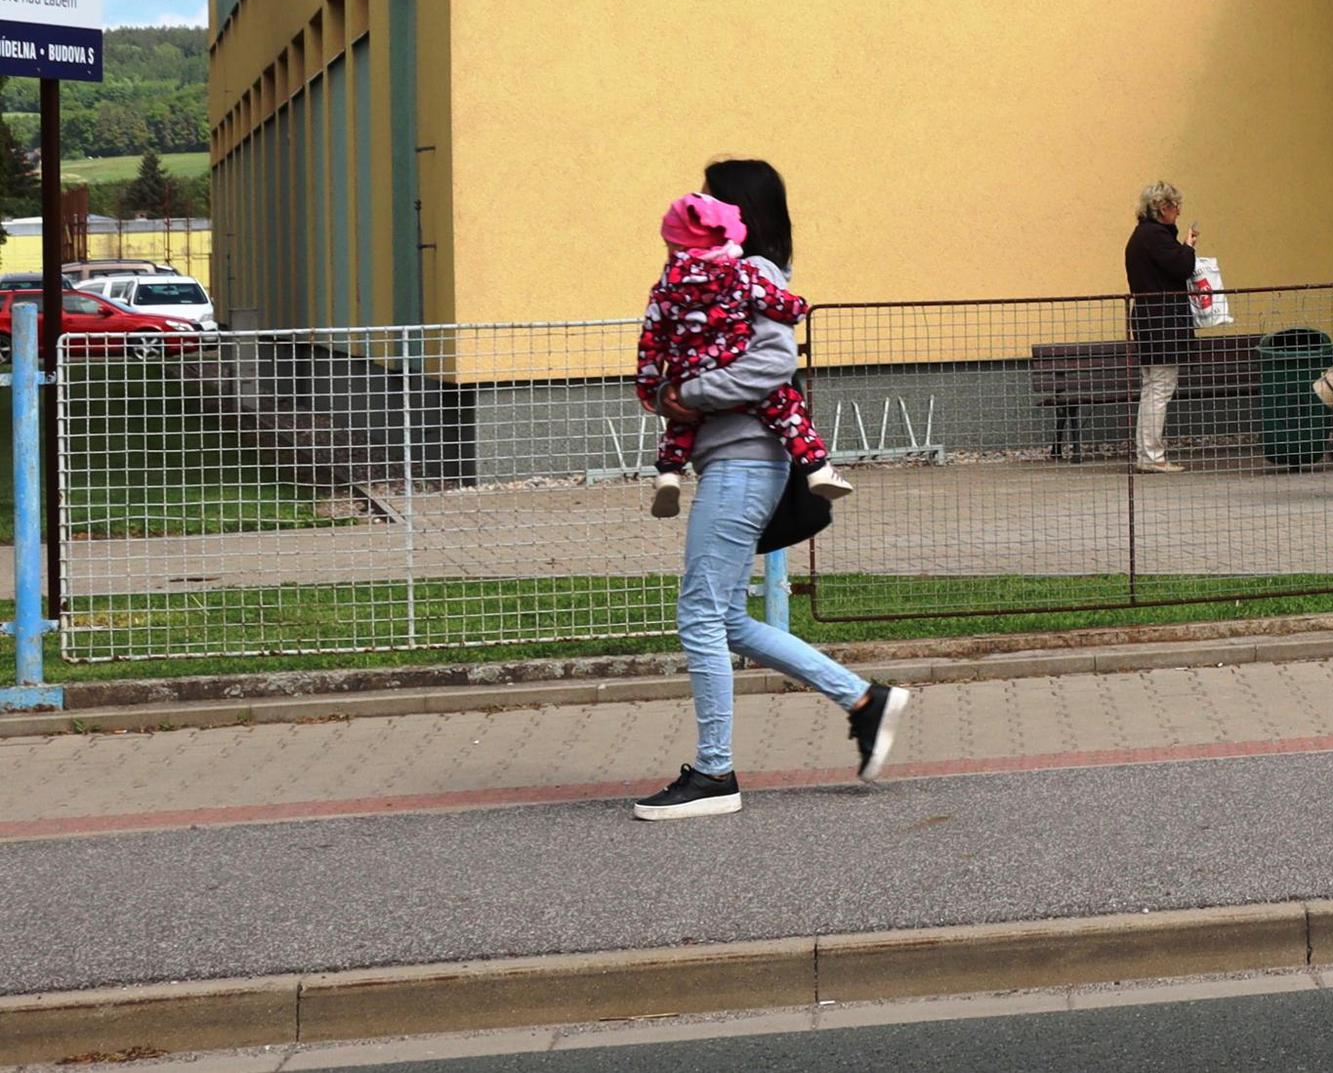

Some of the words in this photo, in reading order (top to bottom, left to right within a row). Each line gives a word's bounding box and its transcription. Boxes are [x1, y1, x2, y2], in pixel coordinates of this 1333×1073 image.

[0, 35, 37, 60] ÍDELNA
[48, 43, 87, 64] BUDOVA
[88, 46, 94, 65] S
